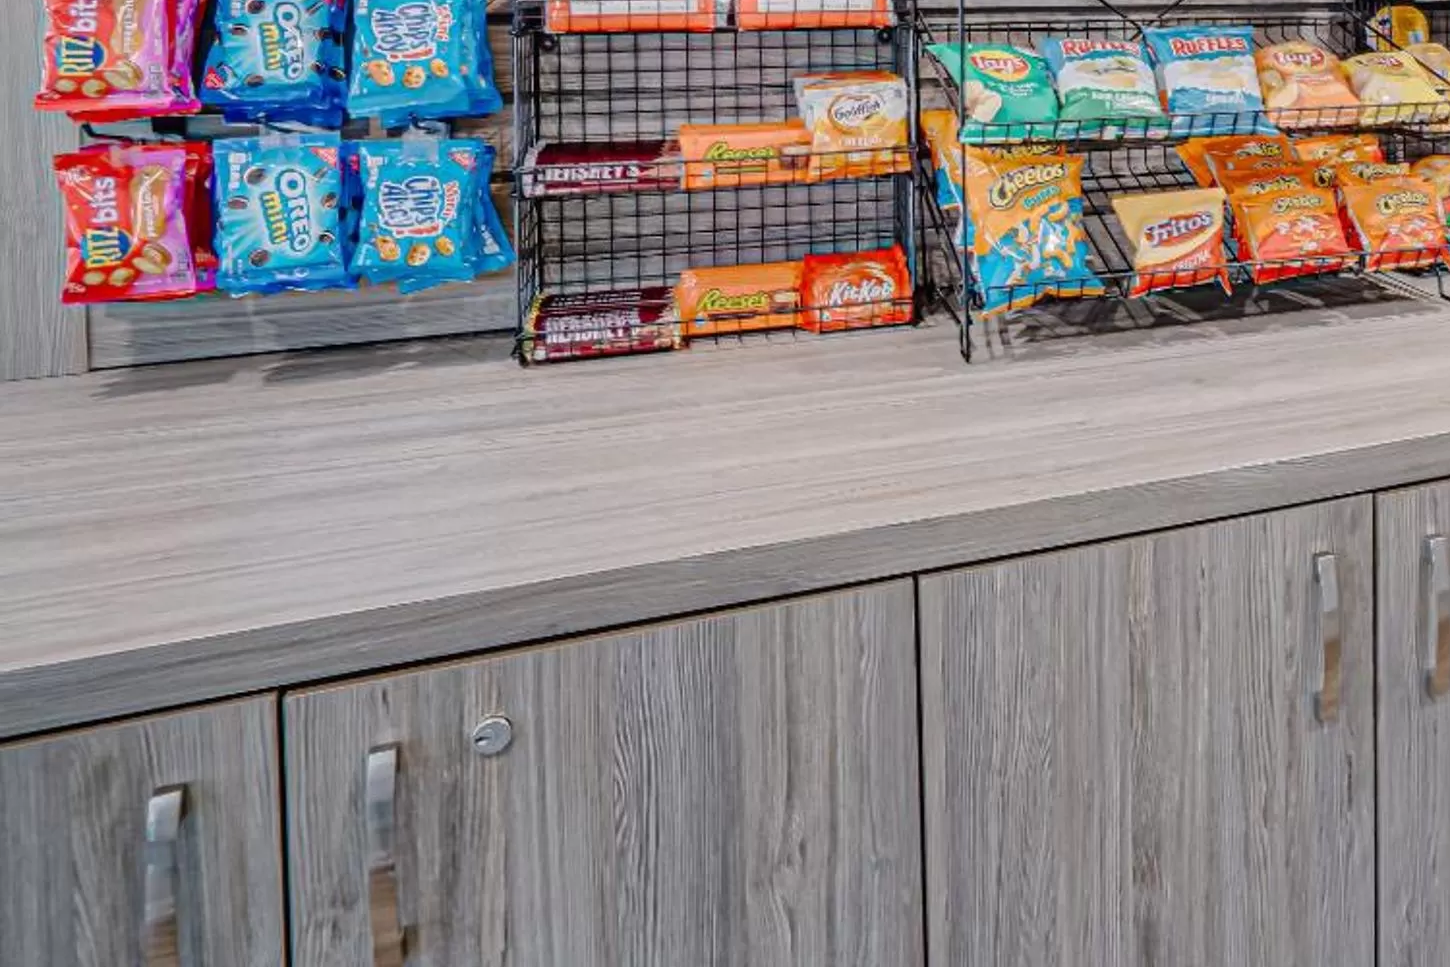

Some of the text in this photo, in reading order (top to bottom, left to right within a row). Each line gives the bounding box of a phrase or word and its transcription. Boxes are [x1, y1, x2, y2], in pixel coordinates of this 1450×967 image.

[260, 23, 280, 70] mini
[275, 3, 305, 79] OREO
[398, 3, 430, 48] Chips
[1171, 37, 1247, 55] RUFFLES
[59, 35, 97, 76] RITZ
[405, 177, 439, 225] Chips
[990, 164, 1067, 208] Cheetos
[86, 176, 122, 268] RITZ bits
[261, 192, 288, 243] mini
[279, 170, 310, 252] OREO
[1145, 211, 1213, 247] Fritos
